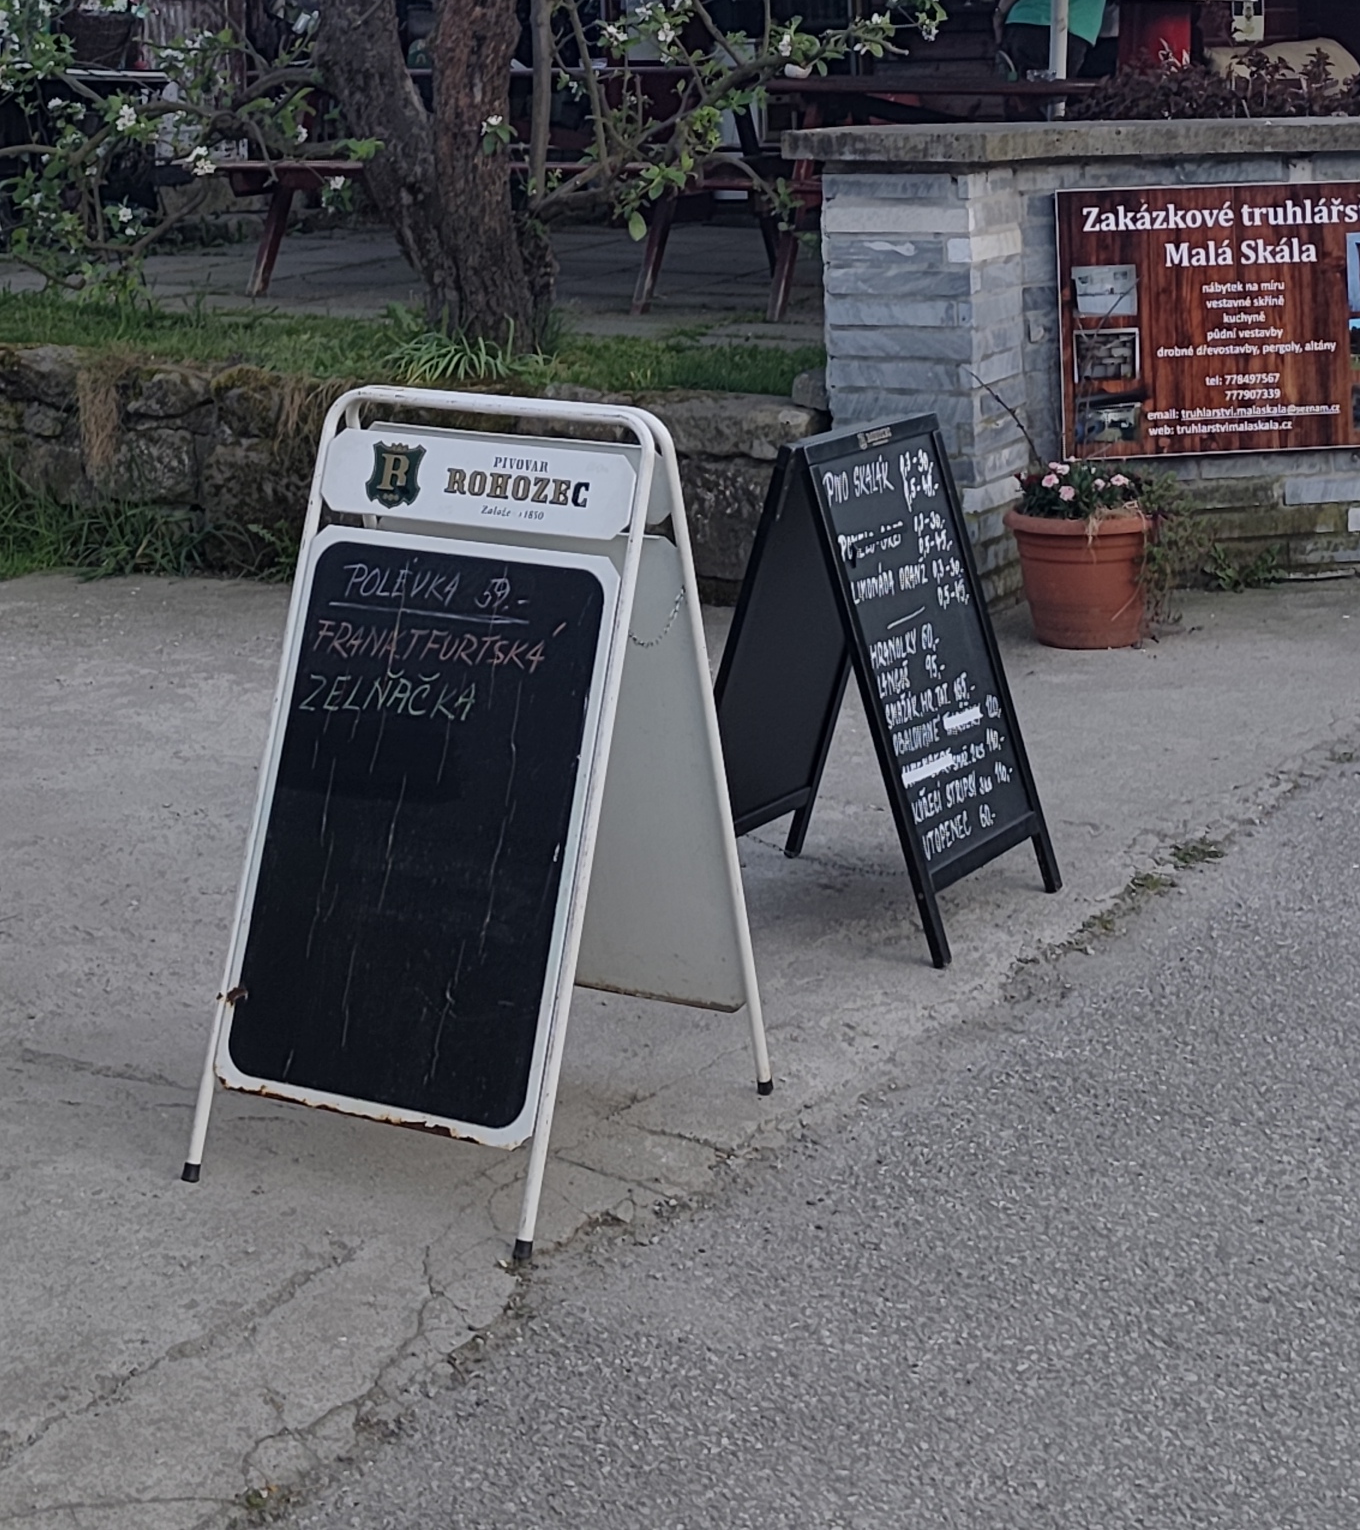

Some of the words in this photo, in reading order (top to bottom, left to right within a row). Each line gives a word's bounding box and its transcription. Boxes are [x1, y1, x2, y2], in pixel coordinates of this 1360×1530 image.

[1082, 201, 1235, 232] Zakázkové
[1165, 240, 1233, 268] Malá
[1240, 237, 1318, 265] Skála
[1202, 281, 1243, 295] nábytek
[1245, 283, 1259, 292] na
[1260, 280, 1285, 292] míru
[1206, 296, 1251, 308] vestavné
[1253, 296, 1285, 307] skříně
[1223, 312, 1266, 325] kuchyně
[1207, 328, 1237, 342] půdní
[1238, 327, 1284, 340] vestavby
[1157, 345, 1193, 358] drobné
[1196, 343, 1260, 356] dřevostavby,
[1262, 341, 1303, 354] pergoly,
[1304, 339, 1337, 352] altány
[1205, 375, 1223, 385] tel:
[1224, 373, 1281, 385] 778497567
[1224, 388, 1281, 401] 777907339
[1147, 408, 1180, 420] email:
[1148, 424, 1175, 436] web:
[1176, 419, 1293, 435] truhlarstvimalaskala.cz
[493, 456, 549, 473] PIVOVAR
[853, 454, 895, 498] SKALÁK
[443, 467, 590, 508] ROHOZEC
[524, 509, 545, 521] 1850
[344, 557, 461, 607] POLÉVKA
[869, 627, 917, 669] HRANOLKY
[298, 669, 477, 722] ZELŇAČKA
[922, 809, 972, 861] UTOPENEC
